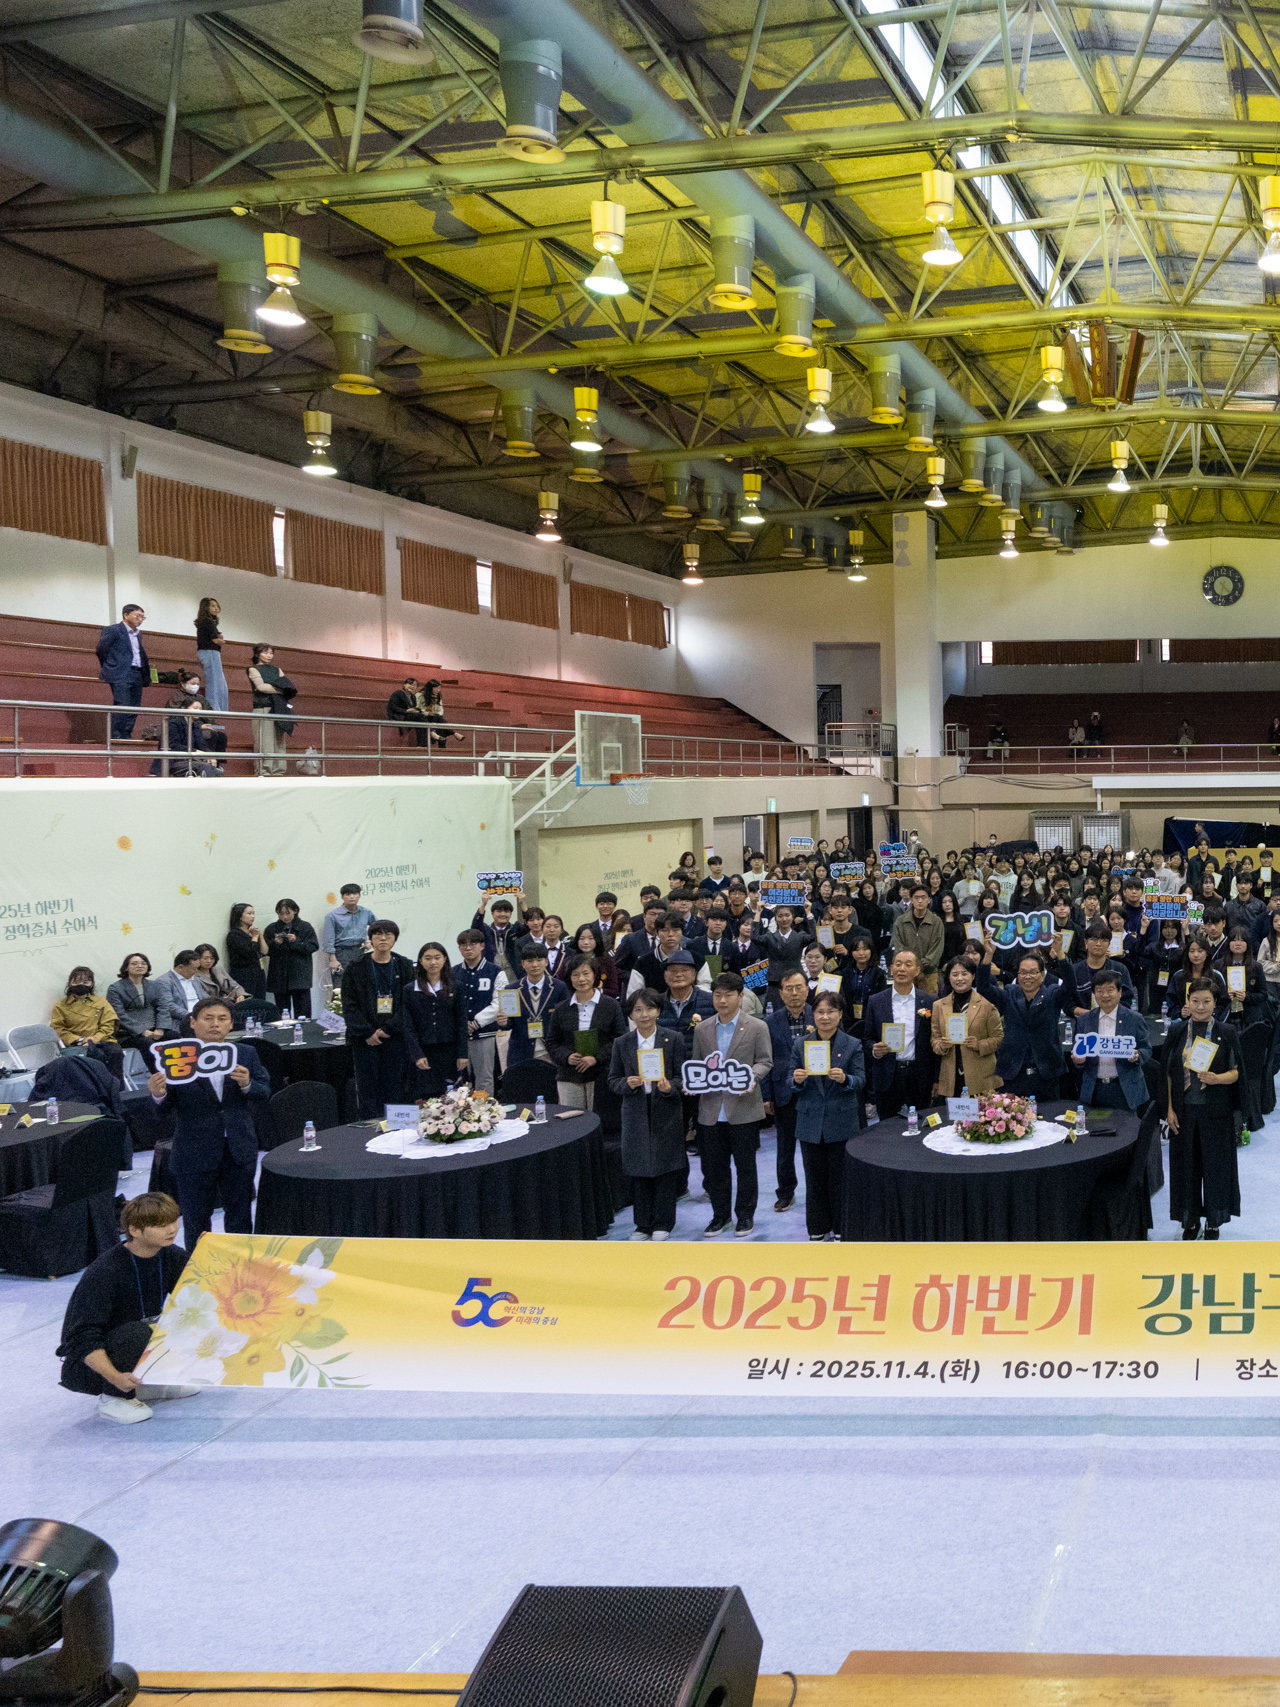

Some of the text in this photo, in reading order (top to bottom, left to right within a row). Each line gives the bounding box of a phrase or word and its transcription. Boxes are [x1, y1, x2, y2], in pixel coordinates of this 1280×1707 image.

[365, 863, 417, 879] 2025년 하반기
[377, 879, 408, 893] 장학증서
[410, 877, 430, 889] 수여식
[35, 898, 74, 916] 하반기
[3, 916, 98, 940] 장학증서 수여식
[1100, 1038, 1133, 1050] 강남구
[164, 1045, 229, 1077] 꿈이
[687, 1065, 748, 1089] 모이는
[451, 1277, 519, 1328] 50
[504, 1306, 545, 1315] 혁신의 강남
[657, 1273, 889, 1336] 2025년
[911, 1273, 1095, 1336] 하반기
[516, 1316, 558, 1325] 미래의 중심
[747, 1358, 790, 1380] 일시
[809, 1358, 980, 1383] 2025.11.4.(화)
[1001, 1360, 1159, 1380] 16:00~17:30
[1235, 1358, 1280, 1381] 장소
